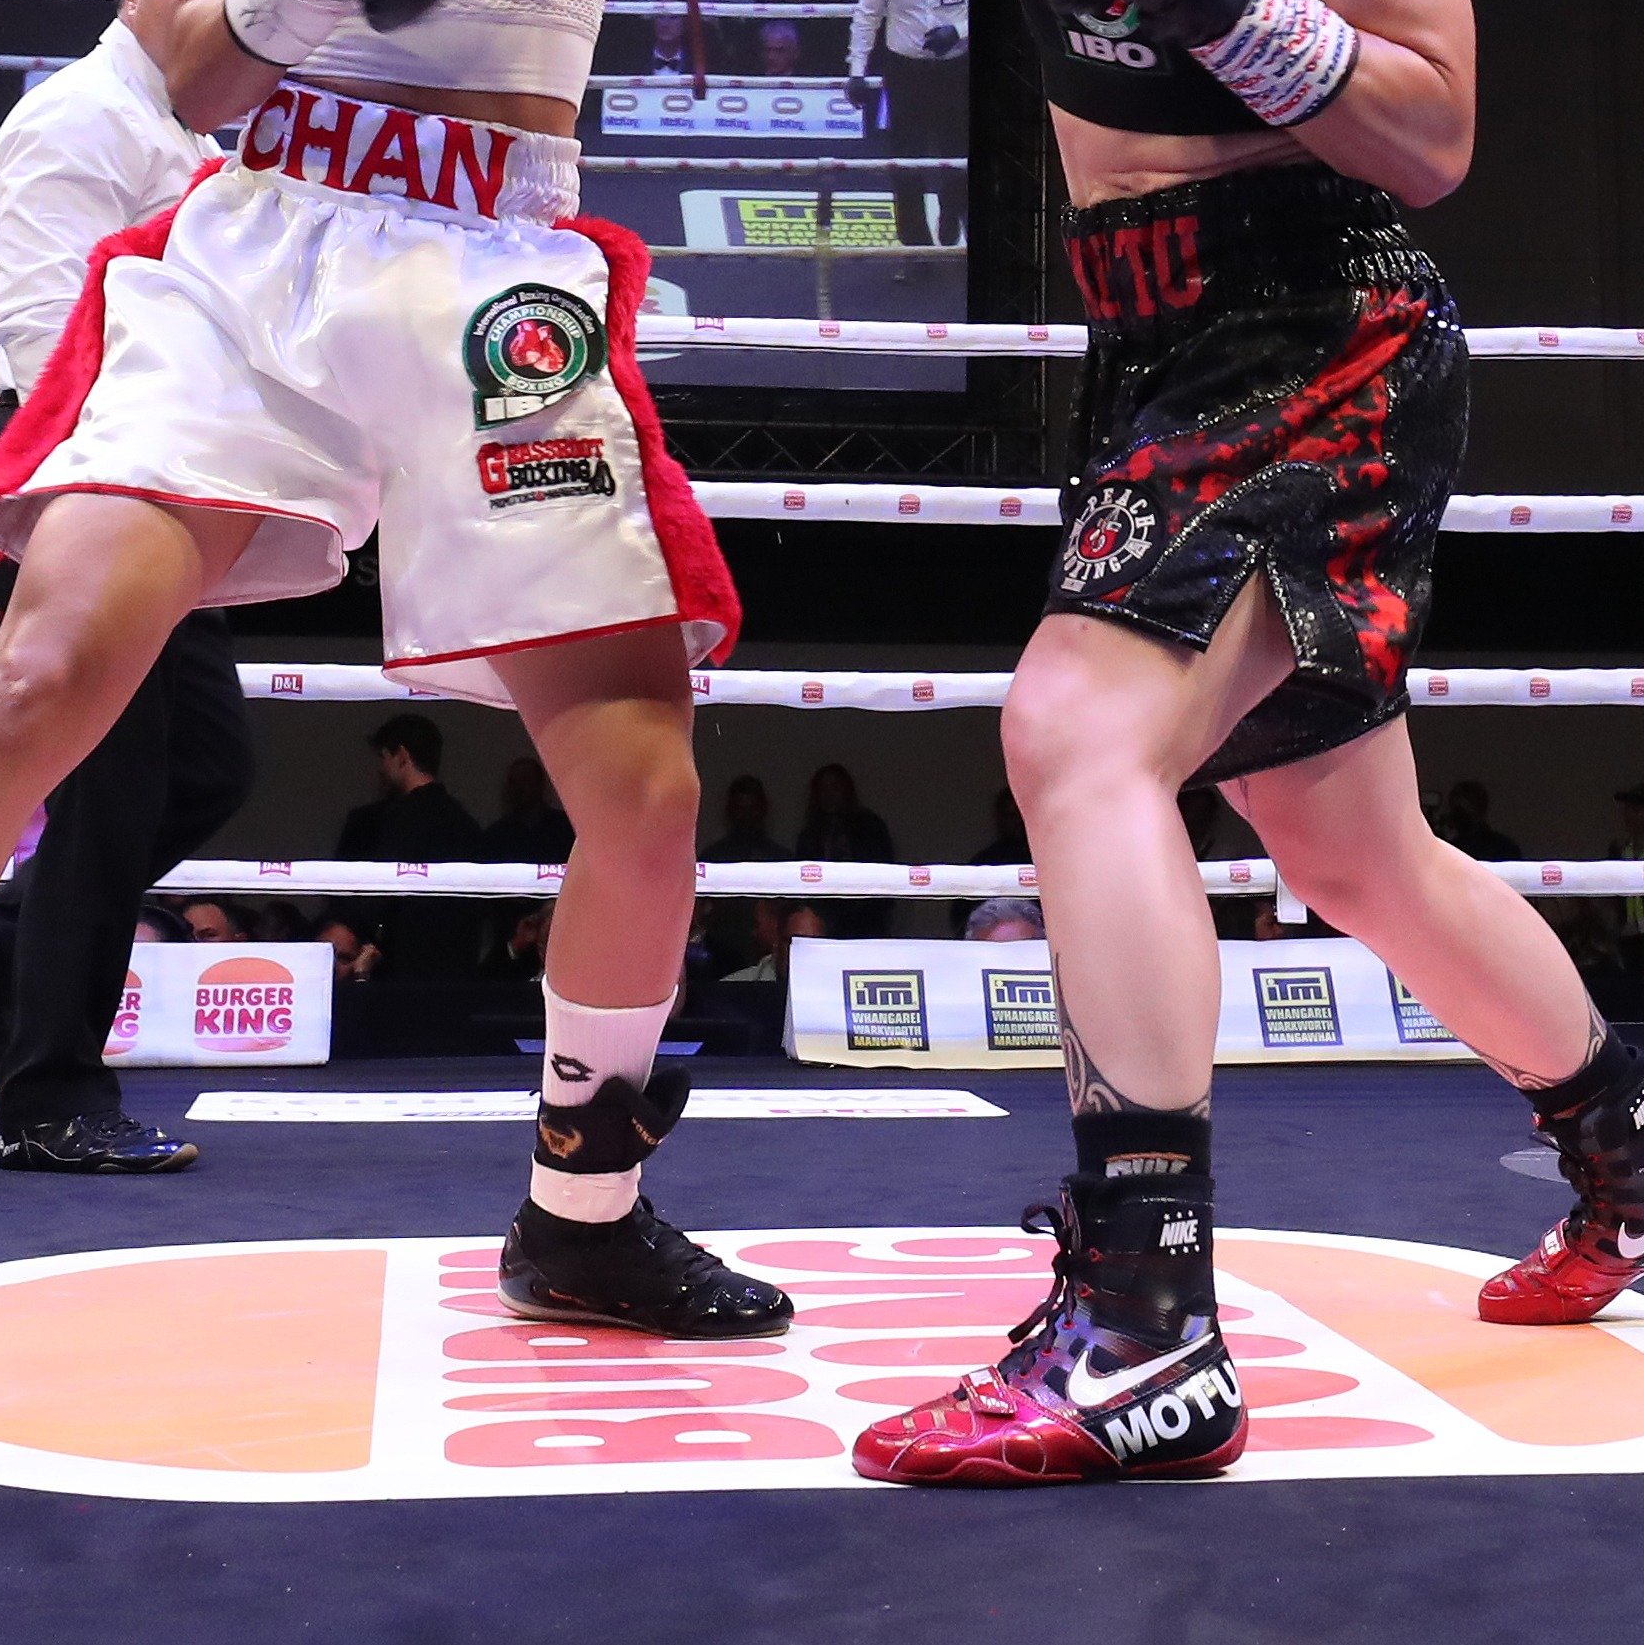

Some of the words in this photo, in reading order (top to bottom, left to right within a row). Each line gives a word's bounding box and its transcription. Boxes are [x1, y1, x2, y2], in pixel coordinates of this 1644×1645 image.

[1068, 30, 1157, 70] IBO
[241, 88, 518, 221] CHAN
[473, 295, 518, 336] International
[490, 306, 582, 342] CHAMPIONSHIP
[1087, 488, 1156, 529] PEACH
[195, 987, 294, 1007] BURGER
[194, 1007, 294, 1035] KING
[852, 1012, 921, 1024] WHANGAREI
[992, 1010, 1057, 1022] WHANGARE
[1264, 1007, 1332, 1020] WHANGAREI
[853, 1024, 922, 1036] WARKWORTH
[1266, 1019, 1334, 1032] WARKWORTH
[853, 1036, 923, 1047] MANGAWHAI
[994, 1035, 1061, 1046] MANGAWHA
[1268, 1031, 1337, 1043] MANGAWHAI
[1159, 1219, 1199, 1248] NIKE
[1104, 1361, 1242, 1459] MOTU
